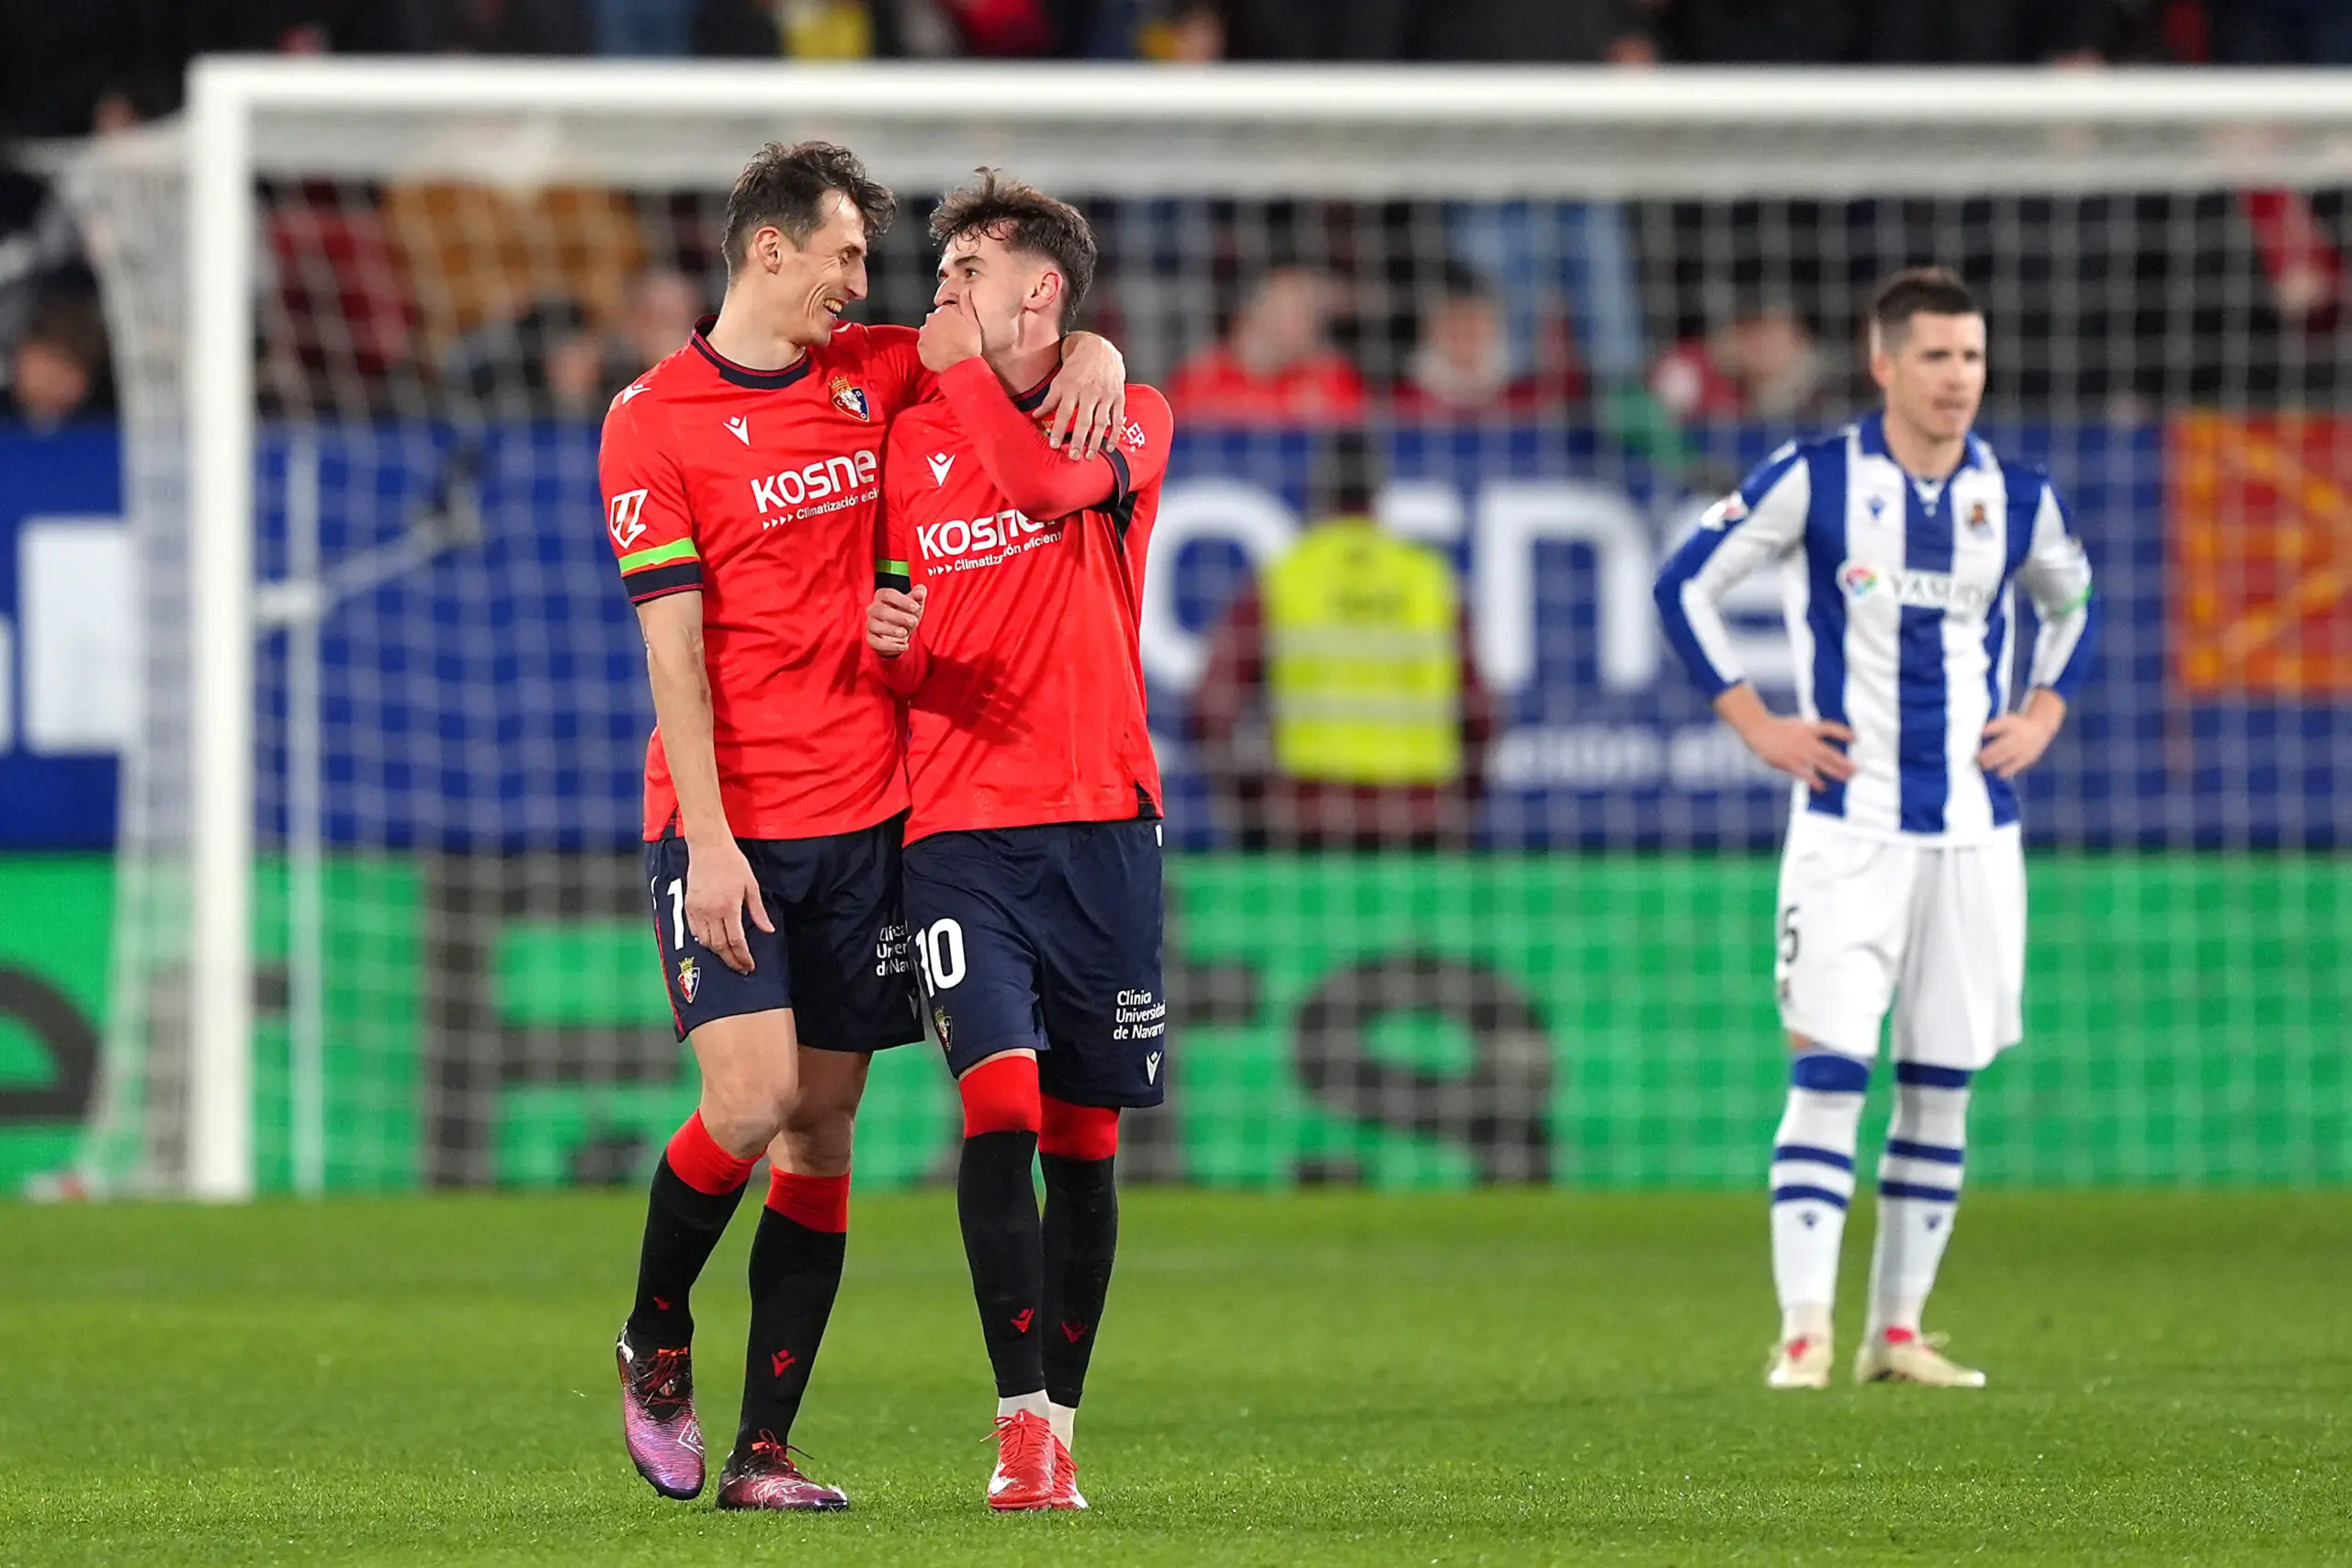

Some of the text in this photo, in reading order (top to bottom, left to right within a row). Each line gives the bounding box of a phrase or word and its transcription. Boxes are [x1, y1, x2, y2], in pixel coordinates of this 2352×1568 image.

[915, 918, 967, 998] 10
[1116, 989, 1152, 1007] Clínica
[1113, 1024, 1129, 1040] de
